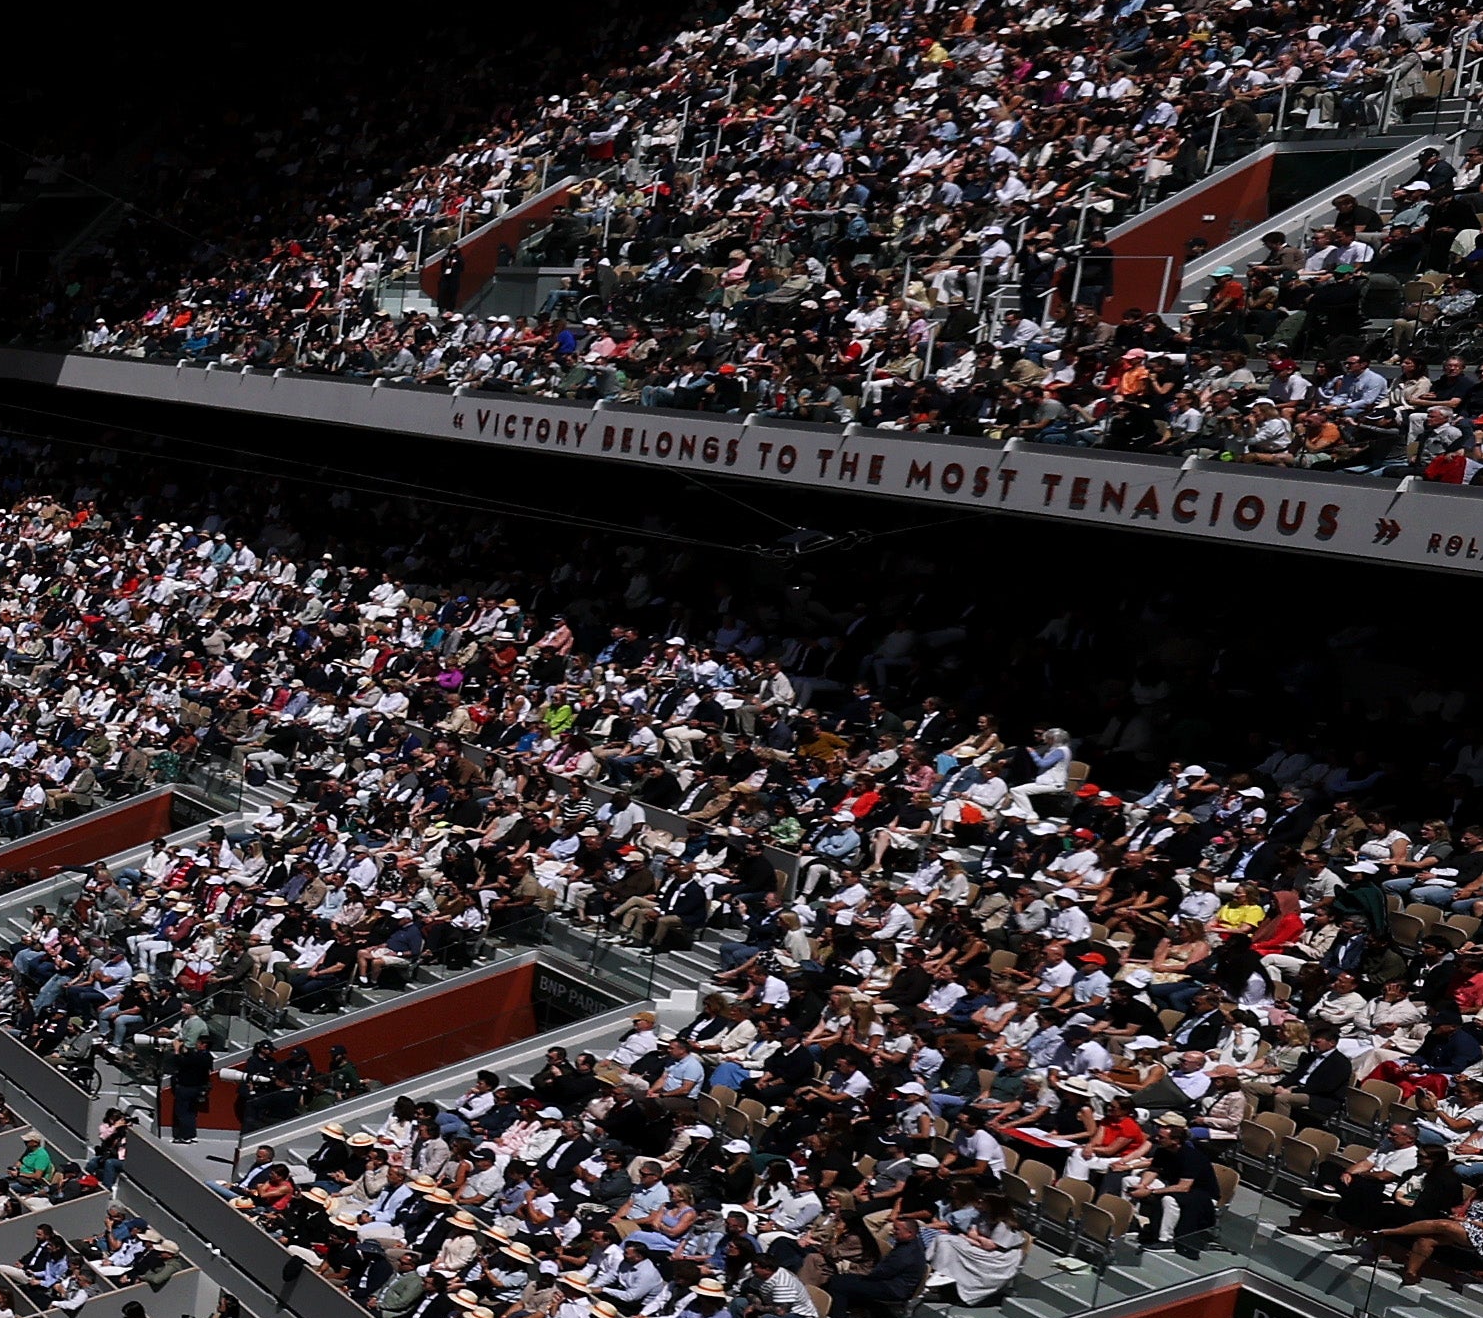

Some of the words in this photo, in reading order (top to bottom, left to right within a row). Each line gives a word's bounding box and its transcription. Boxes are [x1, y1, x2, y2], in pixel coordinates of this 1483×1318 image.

[477, 409, 589, 448] VICTORY
[601, 425, 740, 466] BELONGS
[758, 443, 798, 475] TO
[817, 449, 886, 484] THE
[904, 458, 1019, 503] MOST
[1042, 473, 1341, 542] TENACIOUS
[539, 974, 568, 997] BNP
